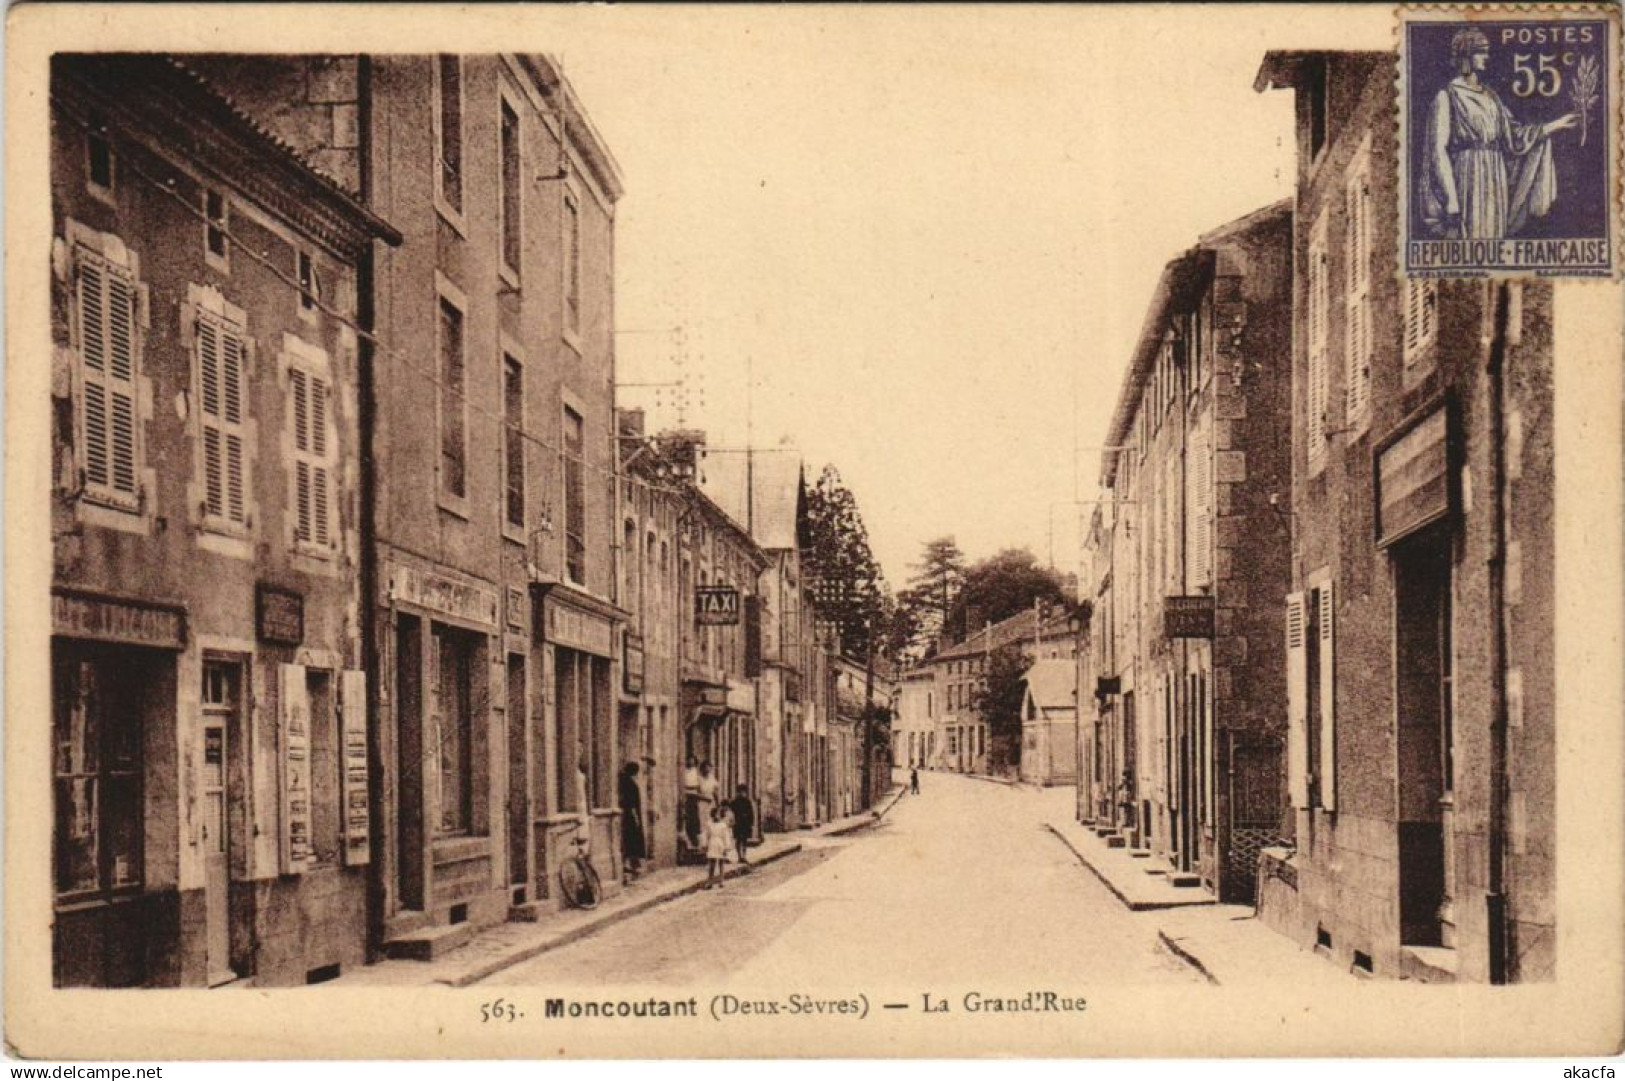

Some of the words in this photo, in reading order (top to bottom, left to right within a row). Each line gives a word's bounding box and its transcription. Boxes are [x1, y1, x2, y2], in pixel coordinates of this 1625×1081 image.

[1502, 26, 1594, 45] POSTES
[1410, 240, 1506, 266] REPUBLIQUE
[1514, 239, 1607, 265] FRANÇAISE
[698, 593, 736, 612] TAXI
[482, 998, 524, 1023] 563.
[544, 998, 697, 1018] Moncoutant
[710, 994, 869, 1021] (Deux-Sèvres)
[922, 994, 949, 1013] La
